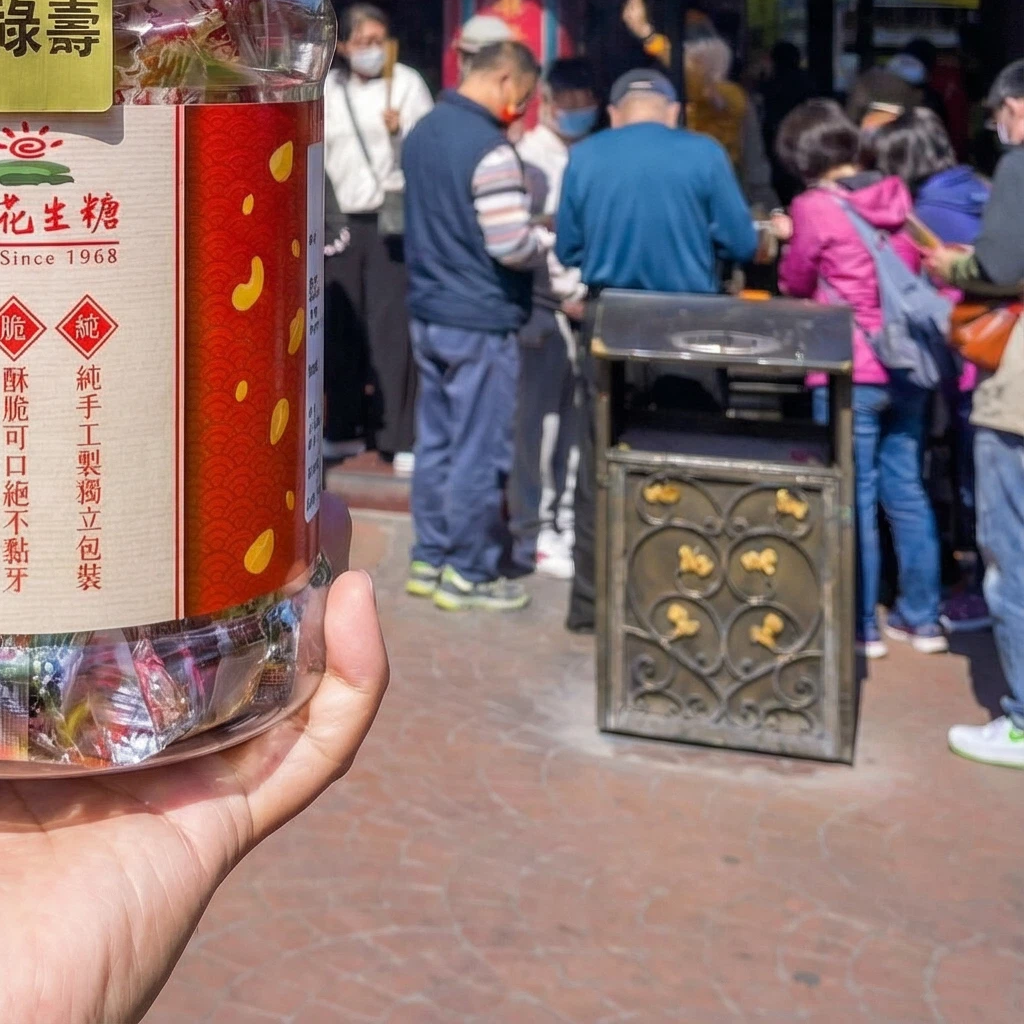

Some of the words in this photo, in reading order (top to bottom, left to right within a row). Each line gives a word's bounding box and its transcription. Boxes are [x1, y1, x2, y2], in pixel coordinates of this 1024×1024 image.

[0, 250, 55, 266] Since
[67, 248, 118, 265] 1968
[0, 314, 26, 341] 脆
